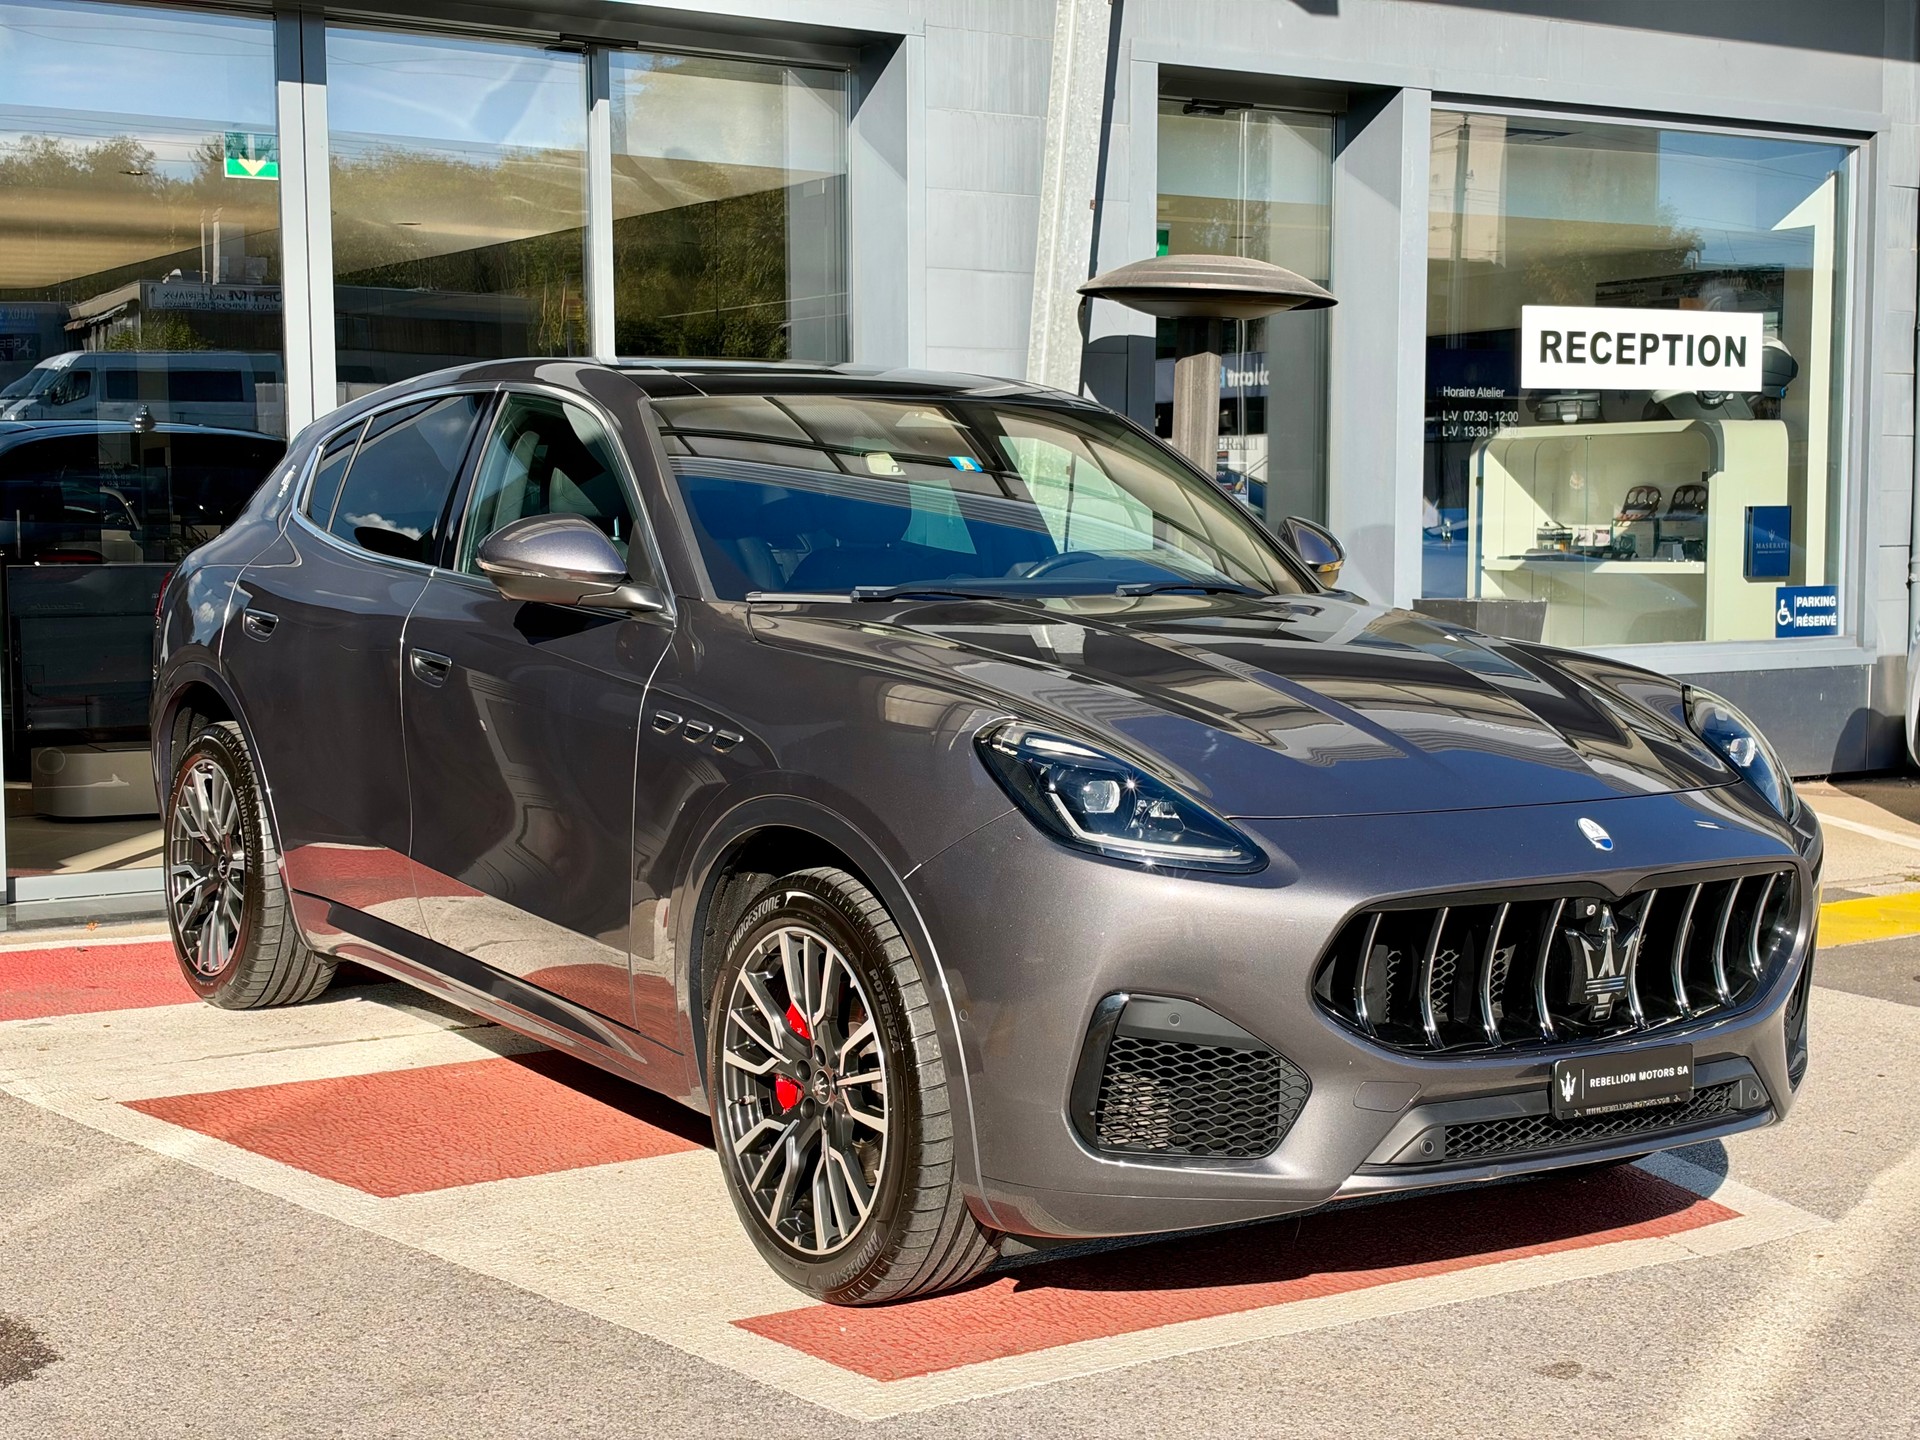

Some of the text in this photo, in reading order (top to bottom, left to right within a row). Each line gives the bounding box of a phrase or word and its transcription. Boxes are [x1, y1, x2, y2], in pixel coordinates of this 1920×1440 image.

[1539, 330, 1747, 368] RECEPTION
[1443, 386, 1505, 398] Horaire Atelier
[1442, 410, 1459, 421] L-V
[1463, 410, 1488, 421] 07:30
[1494, 411, 1519, 422] 12:00
[1442, 426, 1459, 437] L-V
[1464, 426, 1488, 437] 13:30
[1796, 595, 1836, 608] PARKING
[1796, 612, 1837, 627] RÉSERVÉ
[868, 968, 902, 1054] POTENZA
[1589, 1065, 1689, 1088] REBELLION MOTORS SA
